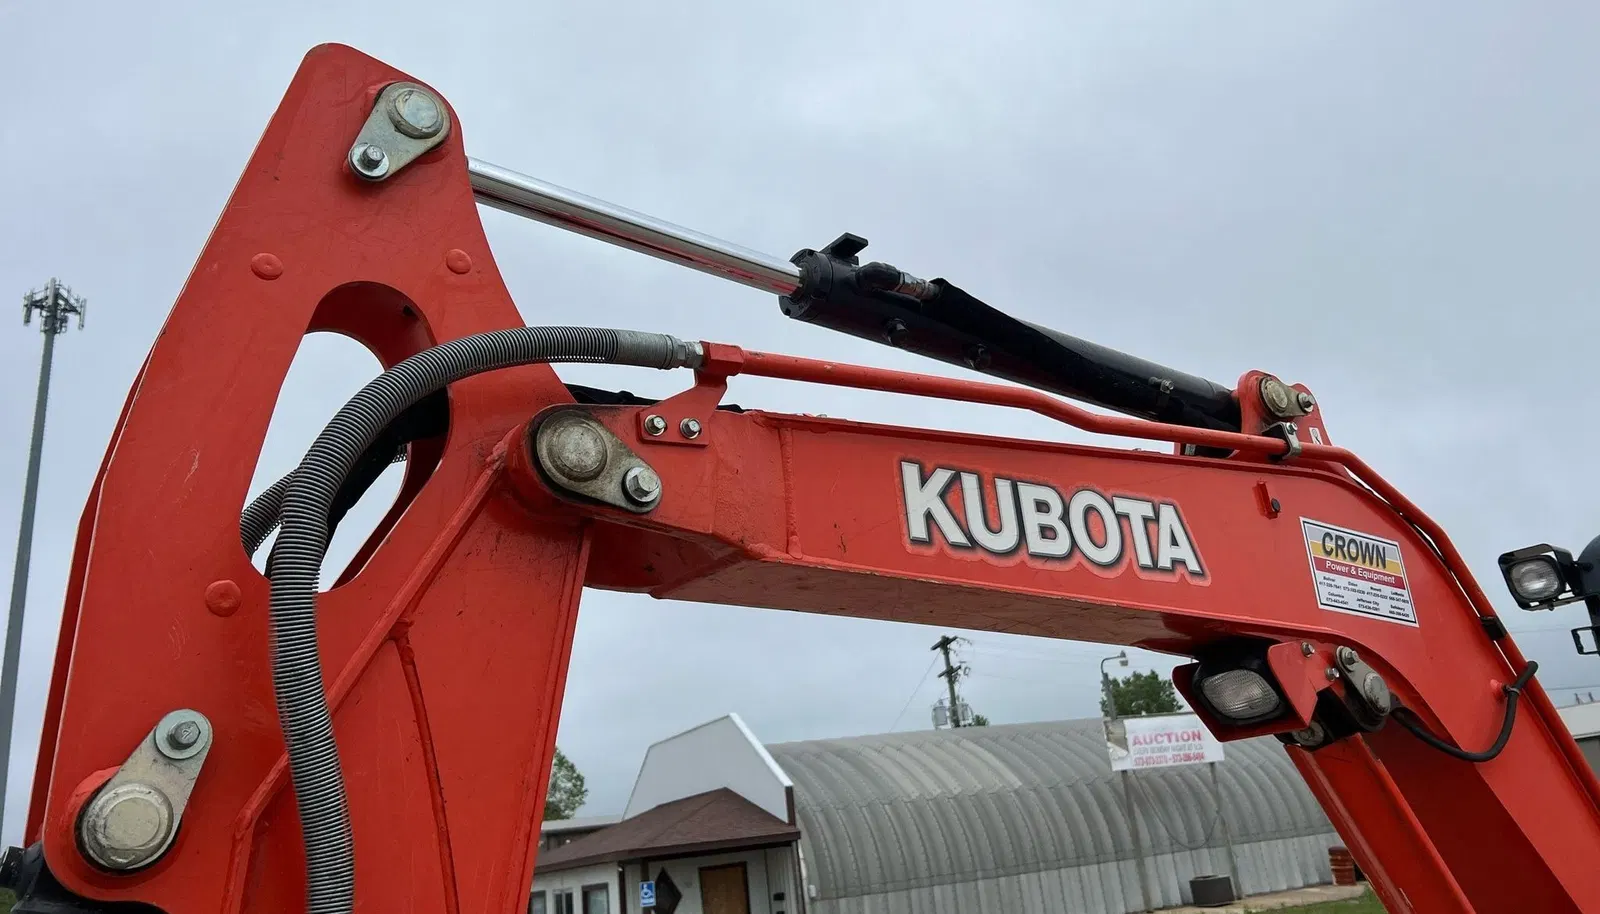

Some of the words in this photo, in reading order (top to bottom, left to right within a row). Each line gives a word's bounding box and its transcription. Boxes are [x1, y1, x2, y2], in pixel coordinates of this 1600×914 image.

[900, 461, 1204, 575] KUBOTA
[1322, 532, 1387, 569] CROWN
[1326, 560, 1348, 573] Power
[1350, 566, 1357, 575] &
[1358, 568, 1395, 584] Equipment
[1132, 731, 1202, 746] AUCTION
